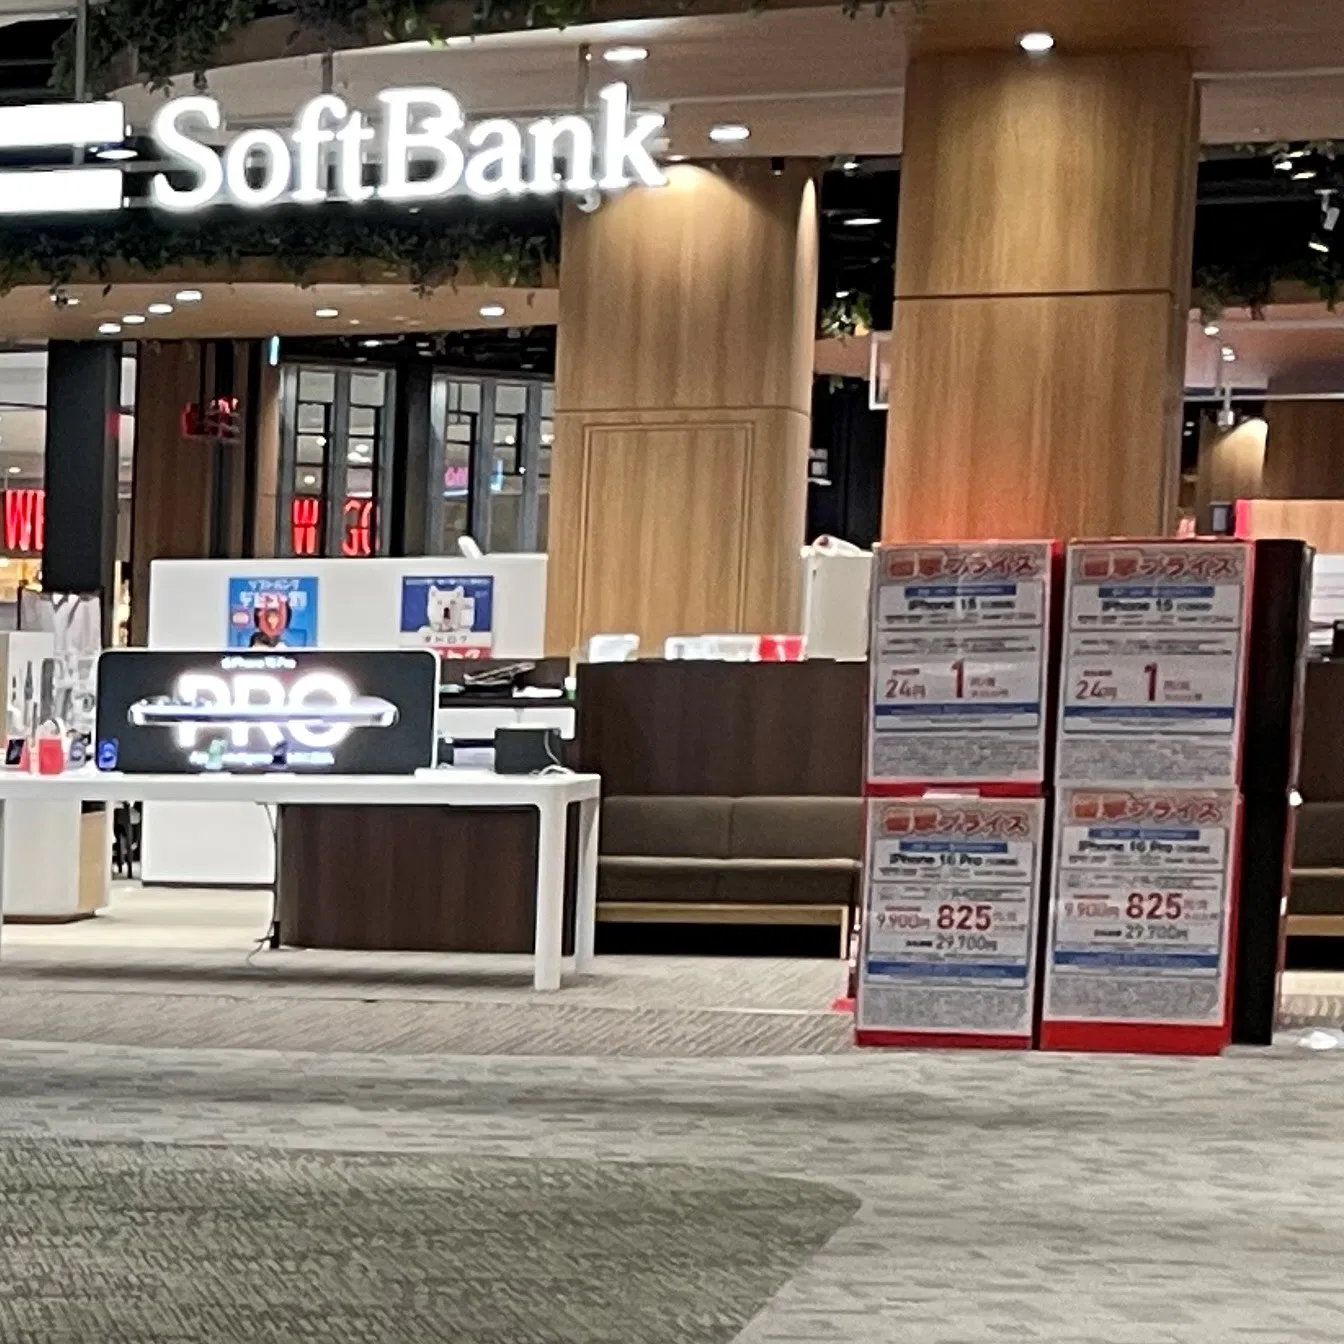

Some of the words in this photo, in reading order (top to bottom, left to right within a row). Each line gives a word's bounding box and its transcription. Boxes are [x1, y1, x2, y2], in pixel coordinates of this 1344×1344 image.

[151, 81, 670, 213] SoftBank
[951, 658, 965, 698] 1
[1144, 662, 1157, 701] 1
[175, 672, 354, 748] PRO
[937, 904, 993, 931] 825
[1126, 892, 1184, 920] 825
